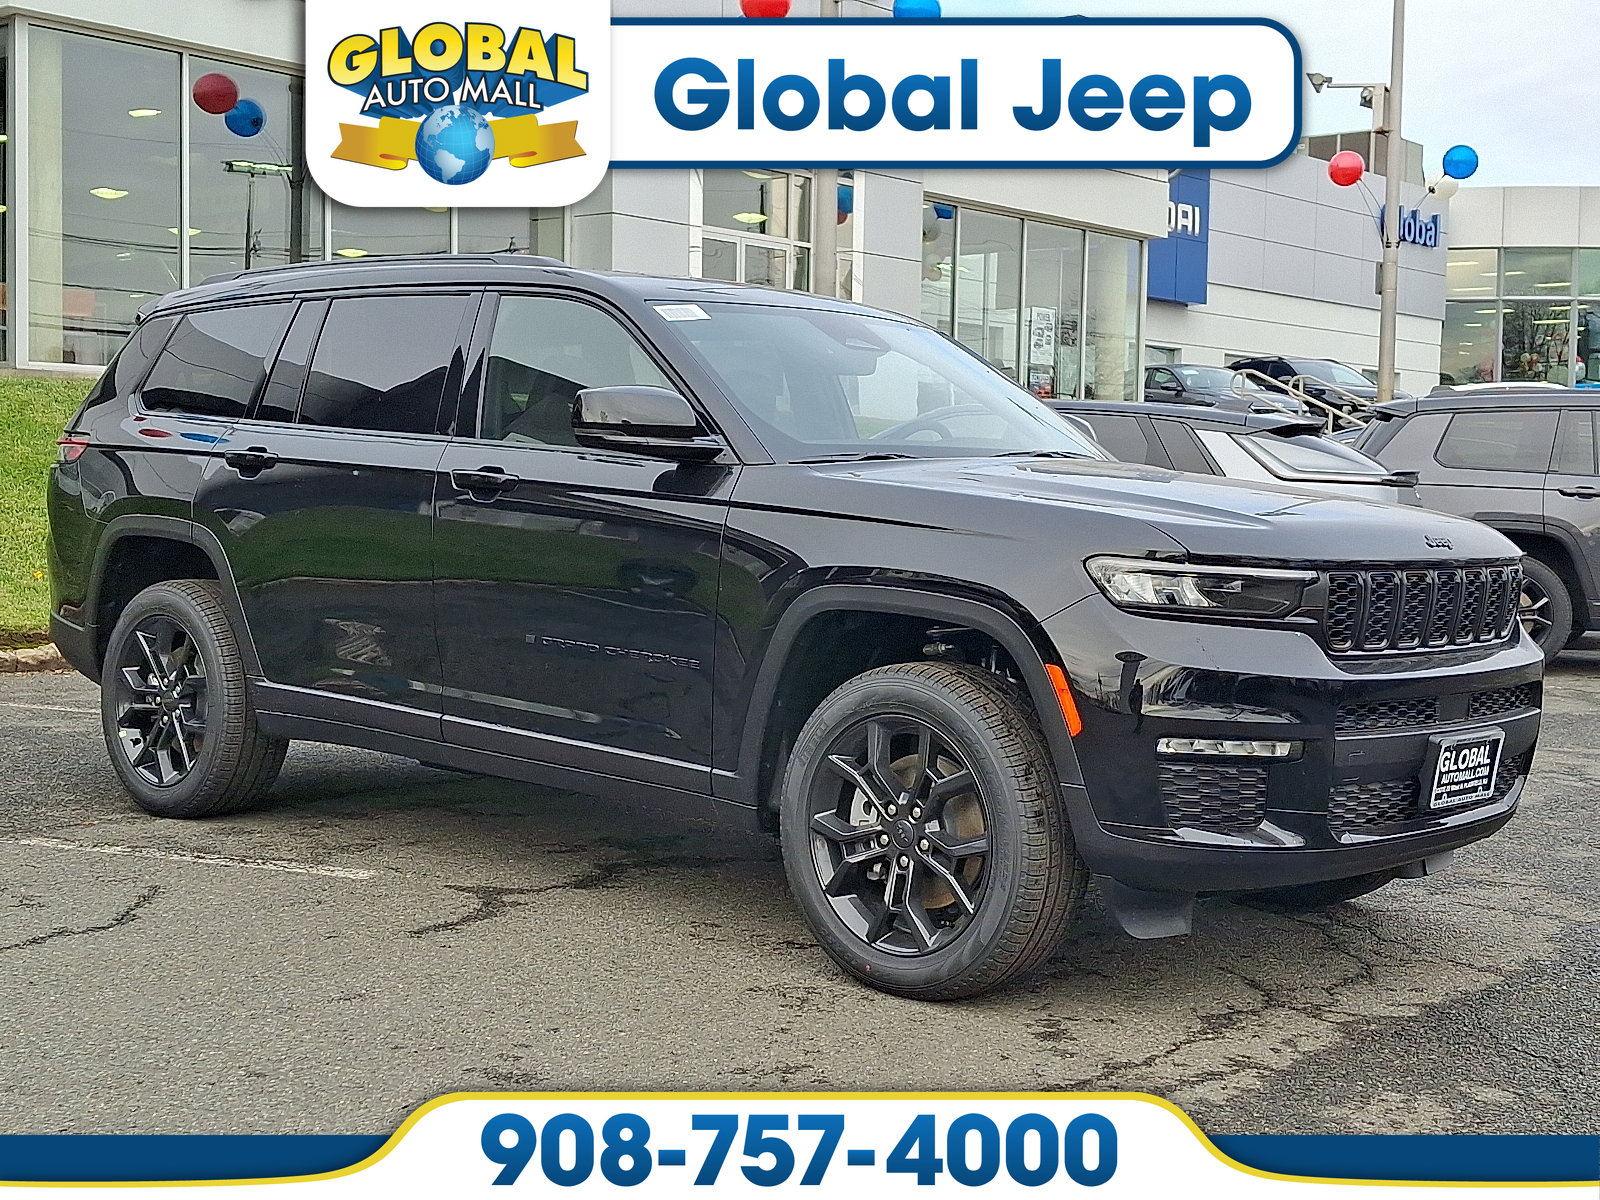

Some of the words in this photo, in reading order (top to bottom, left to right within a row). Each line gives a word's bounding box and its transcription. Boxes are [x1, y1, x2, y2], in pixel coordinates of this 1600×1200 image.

[1380, 204, 1441, 248] lobal
[1424, 534, 1454, 550] Jeep
[1440, 745, 1491, 773] GLOBAL
[1441, 765, 1490, 785] AUTOMALL.COM
[1433, 798, 1456, 807] GLOBAL
